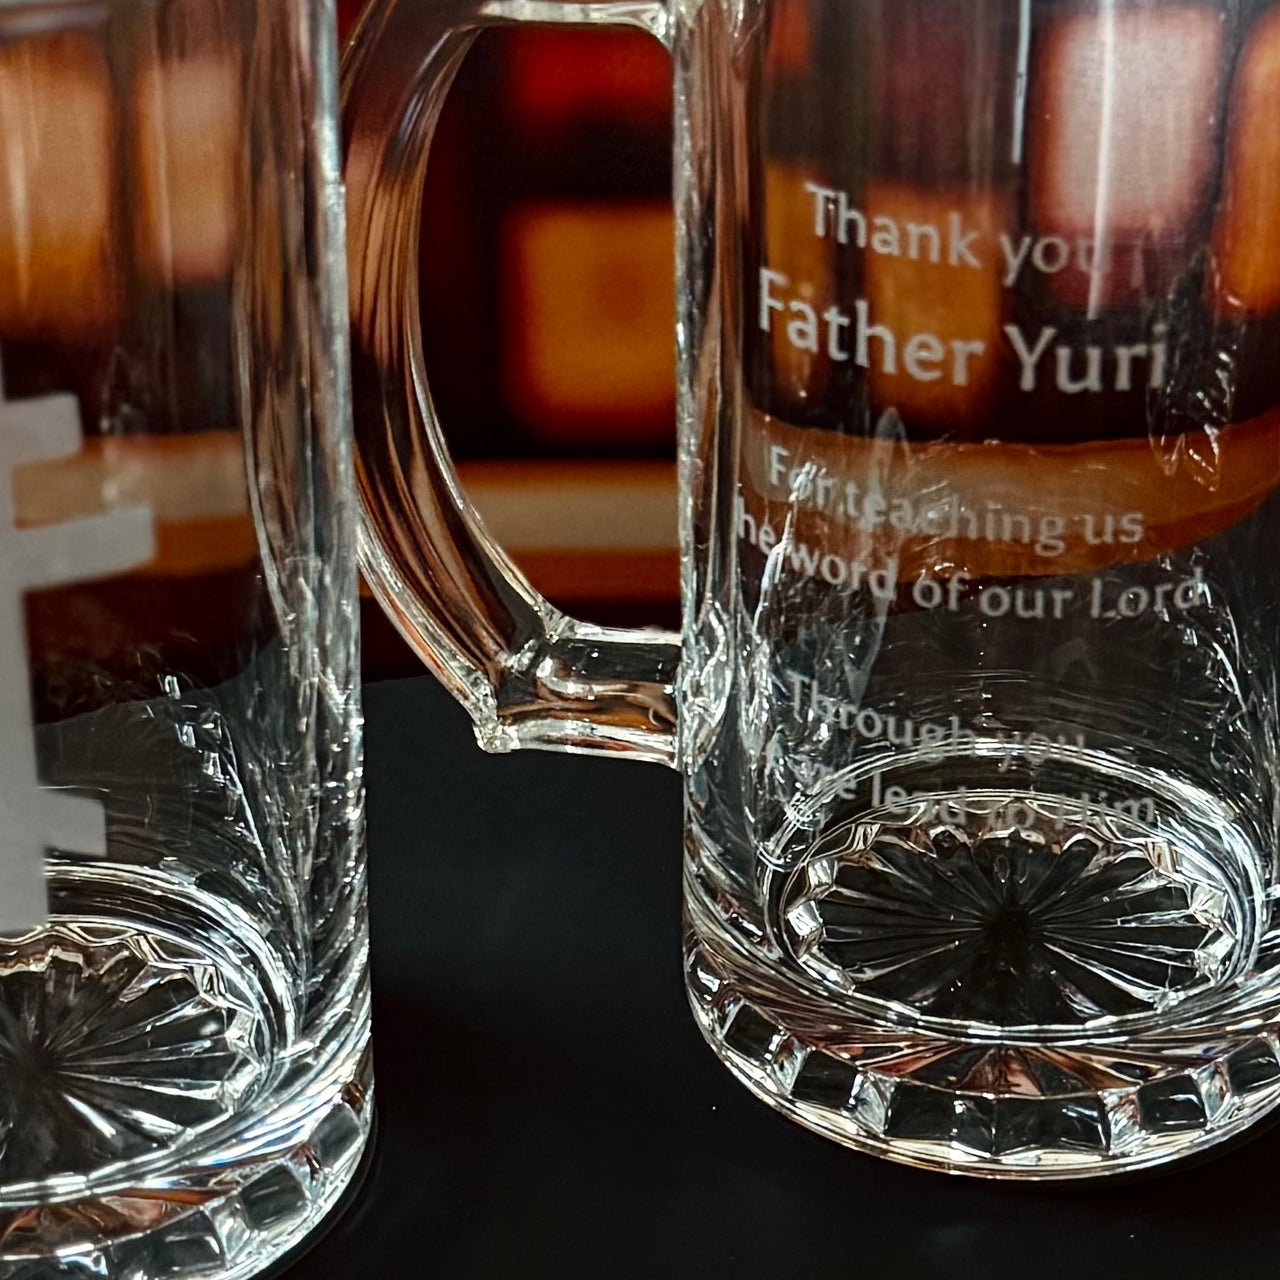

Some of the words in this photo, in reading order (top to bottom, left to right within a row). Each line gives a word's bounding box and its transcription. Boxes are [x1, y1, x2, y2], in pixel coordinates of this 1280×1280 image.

[804, 182, 982, 269] Thank
[999, 231, 1113, 288] you
[758, 266, 986, 387] Father
[1003, 323, 1169, 395] Yuri
[843, 478, 1067, 557] teaching
[1080, 511, 1146, 546] us
[787, 542, 898, 603] word
[911, 570, 972, 612] of
[978, 585, 1075, 620] our
[1089, 564, 1205, 620] Lord
